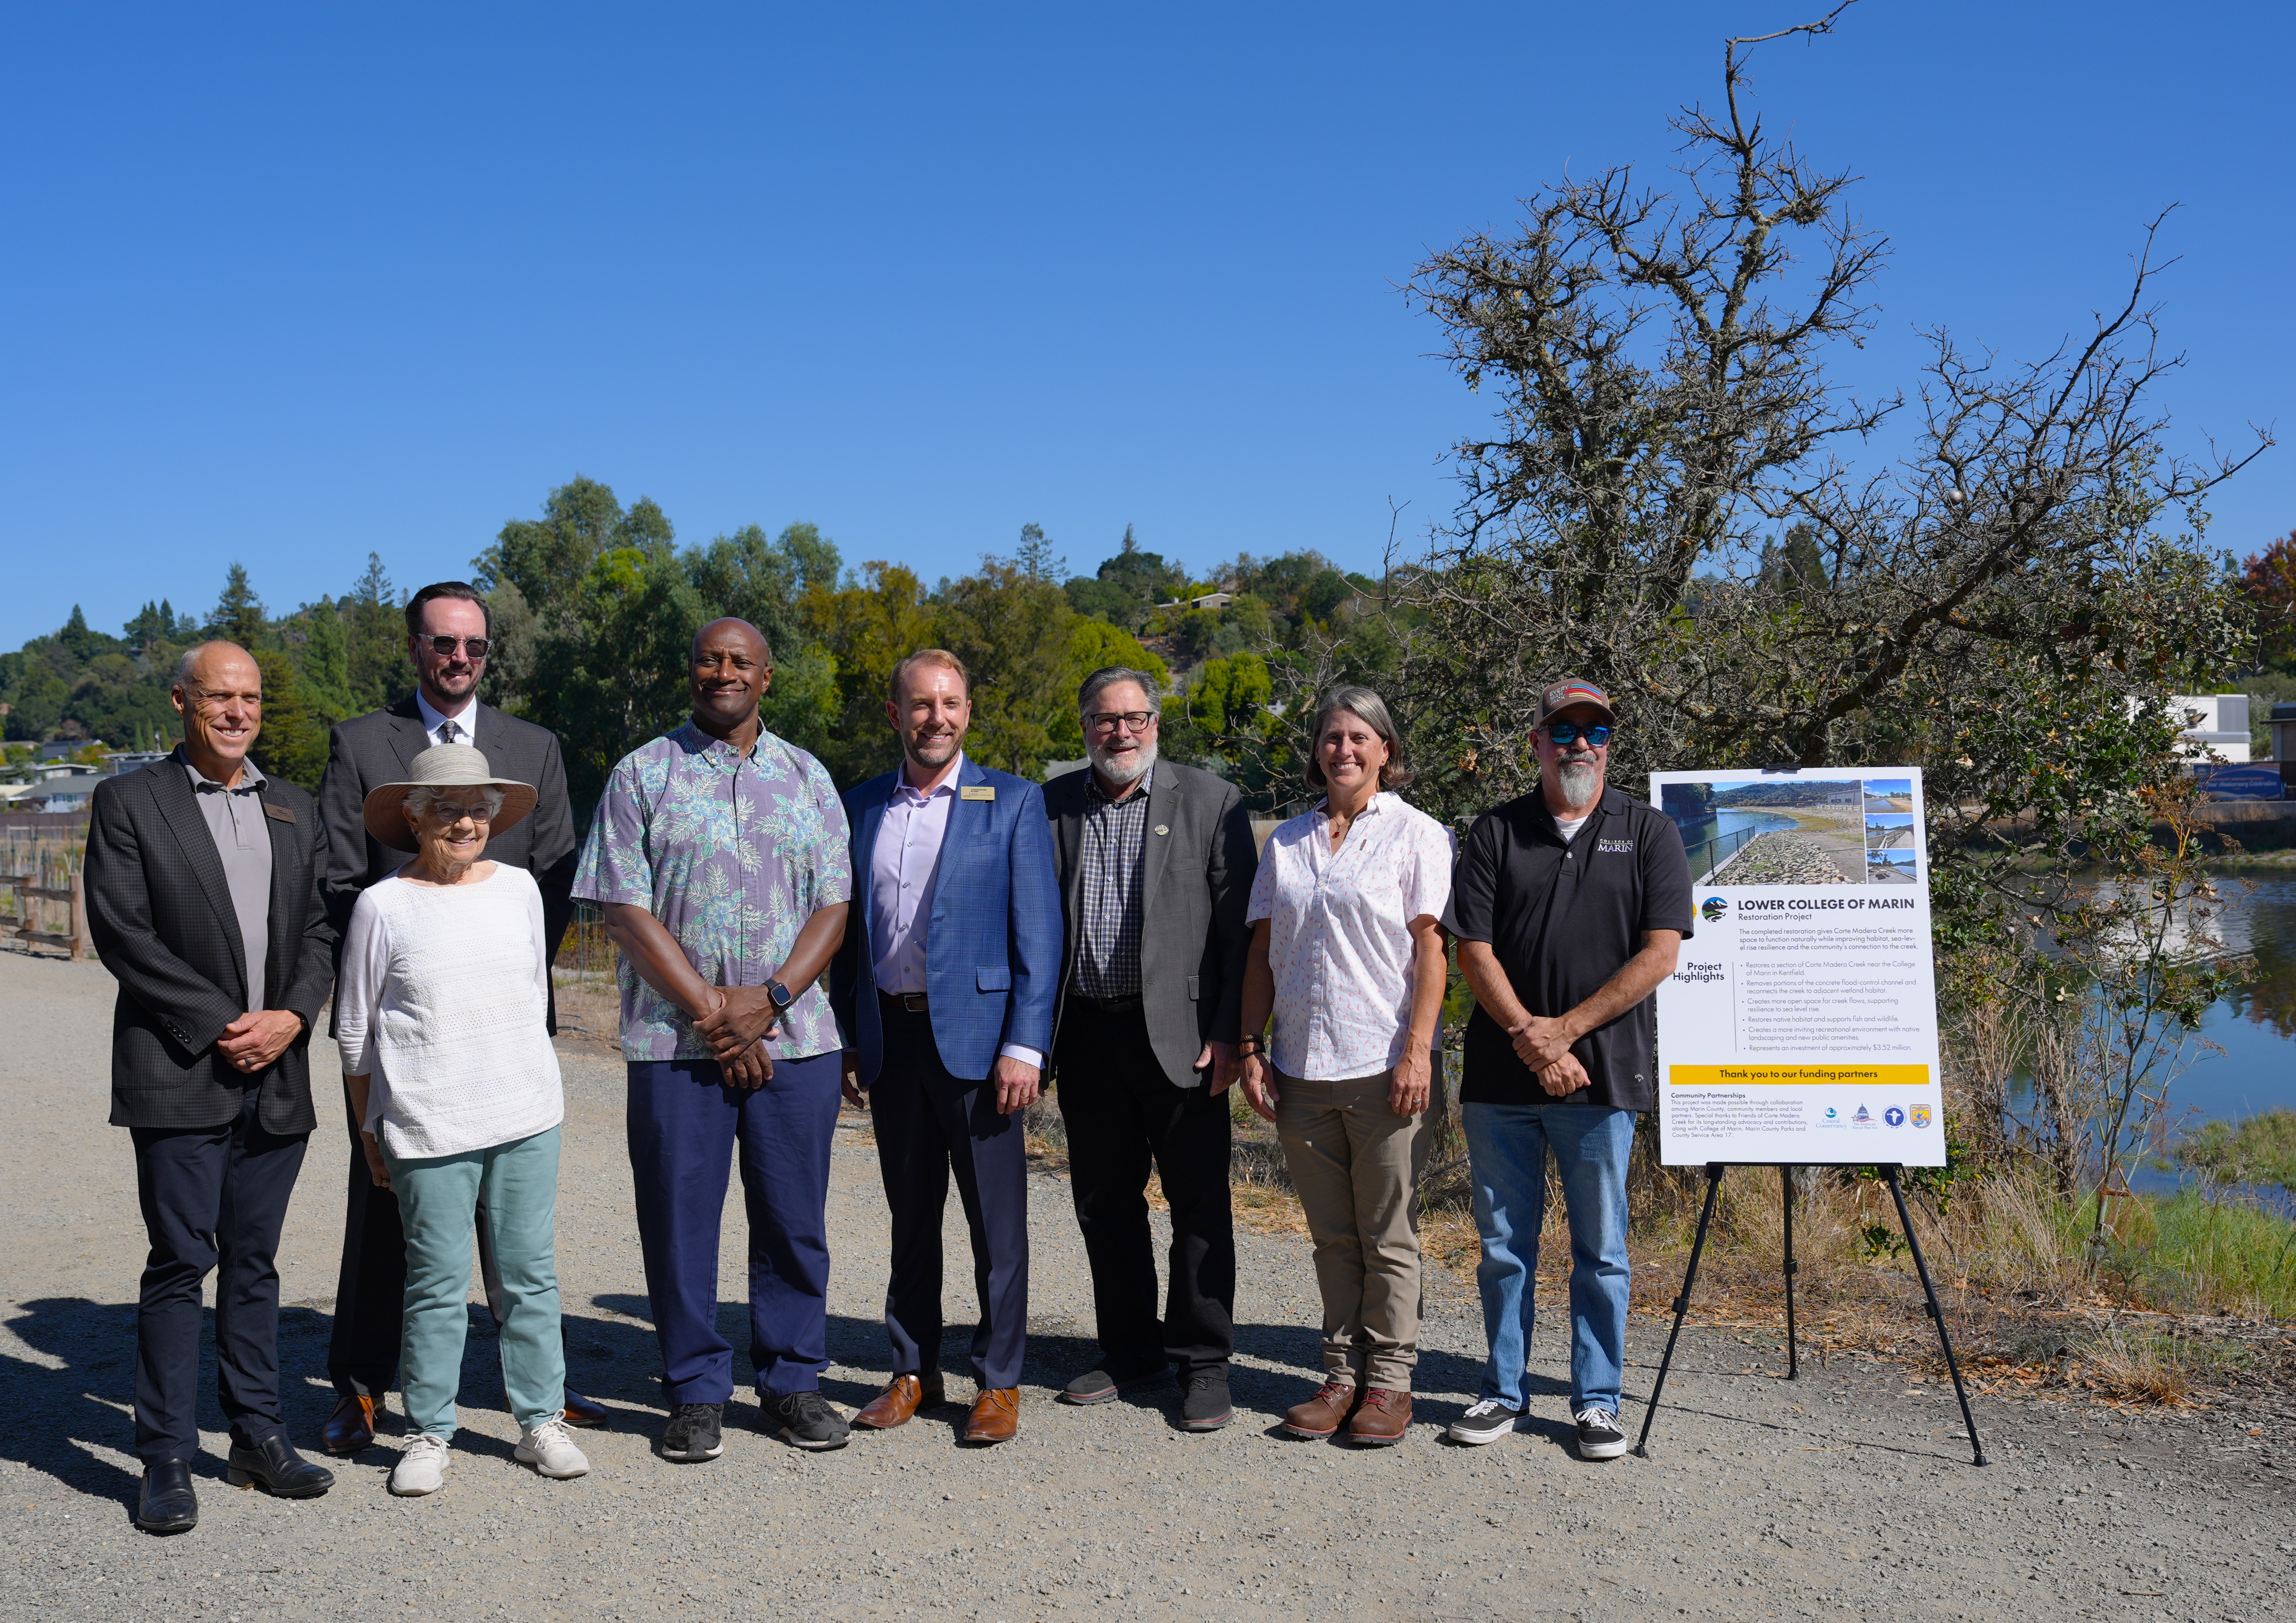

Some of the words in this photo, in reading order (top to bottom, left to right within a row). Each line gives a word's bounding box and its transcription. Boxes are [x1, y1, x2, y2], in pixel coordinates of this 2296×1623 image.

[1549, 685, 1569, 696] EVERY
[1550, 691, 1563, 701] MAN
[1550, 695, 1565, 705] JACK
[1597, 843, 1633, 852] MARIN
[1738, 900, 1785, 910] LOWER
[1788, 899, 1845, 909] COLLEGE
[1848, 899, 1865, 909] OF
[1868, 899, 1914, 909] MARIN
[1785, 913, 1812, 921] Project
[1688, 962, 1722, 973] Project
[1673, 971, 1724, 983] Highlights
[1799, 1069, 1835, 1080] funding
[1838, 1071, 1878, 1079] partners
